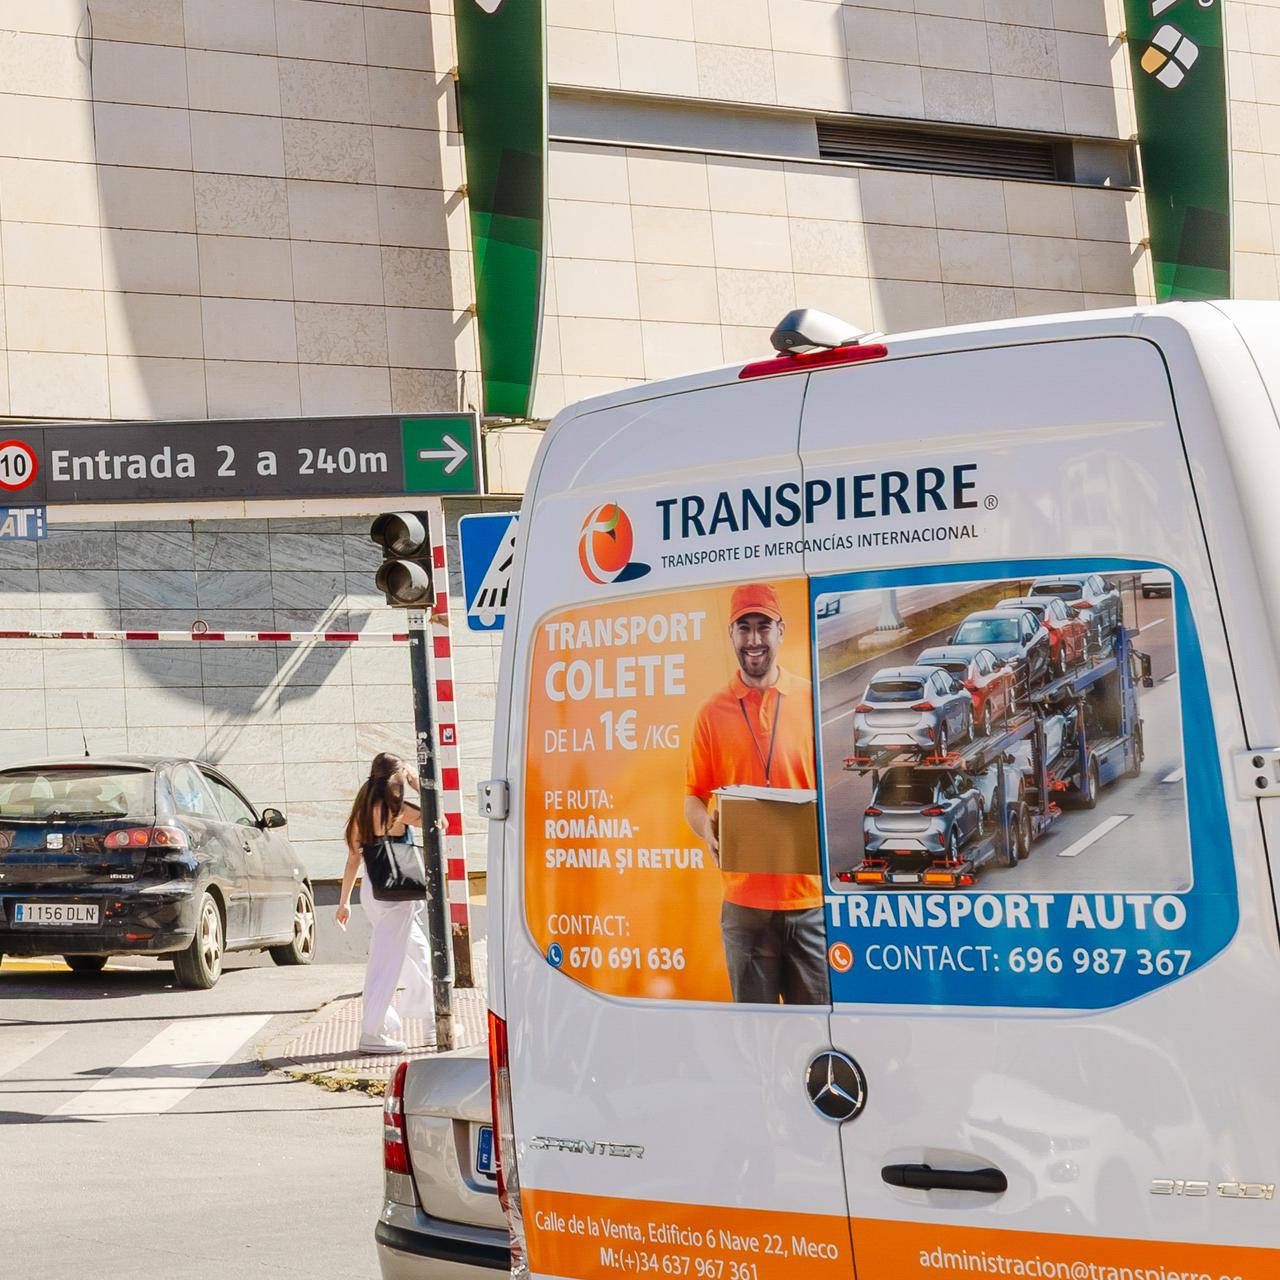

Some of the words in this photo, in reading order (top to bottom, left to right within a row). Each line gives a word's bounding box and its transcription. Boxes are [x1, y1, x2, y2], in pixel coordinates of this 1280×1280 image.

[0, 453, 26, 478] 10
[51, 445, 196, 481] Entrada
[217, 445, 237, 478] 2
[257, 452, 278, 477] a
[298, 447, 388, 475] 240m
[656, 463, 979, 541] TRANSPIERRE
[661, 547, 741, 569] TRANSPORTE
[744, 544, 761, 559] DE
[764, 533, 854, 557] MERCANCÍAS
[857, 524, 979, 547] INTERNACIONAL
[545, 611, 706, 652] TRANSPORT
[545, 654, 686, 703] COLETE
[544, 729, 569, 753] DE
[572, 728, 595, 752] LA
[599, 708, 638, 751] 1€
[642, 723, 681, 751] /KG
[544, 790, 563, 810] PE
[567, 789, 614, 810] RUTA:
[544, 814, 639, 839] ROMÂNIA-
[544, 848, 611, 869] SPANIA
[637, 848, 704, 869] RETUR
[28, 906, 63, 920] 1156
[66, 907, 94, 921] DLN
[824, 895, 1059, 929] TRANSPORT
[1066, 894, 1187, 930] AUTO
[547, 913, 630, 937] CONTACT:
[569, 946, 603, 969] 670
[607, 947, 641, 969] 691
[647, 947, 686, 970] 636
[865, 944, 1000, 972] CONTACT:
[1008, 946, 1063, 973] 696
[1072, 948, 1127, 974] 987
[1136, 949, 1192, 976] 367
[529, 1136, 645, 1160] SPRINTER
[1149, 1178, 1209, 1197] 315
[1216, 1181, 1276, 1200] CDI
[535, 1210, 565, 1234] Calle
[568, 1214, 585, 1235] de
[588, 1215, 600, 1237] la
[600, 1218, 646, 1244] Venta,
[648, 1222, 703, 1248] Edificio
[706, 1229, 716, 1248] 6
[720, 1229, 759, 1252] Nave
[763, 1233, 789, 1258] 22,
[792, 1235, 839, 1260] Meco
[662, 1256, 690, 1276] 637
[695, 1259, 725, 1279] 967
[728, 1261, 758, 1280] 361
